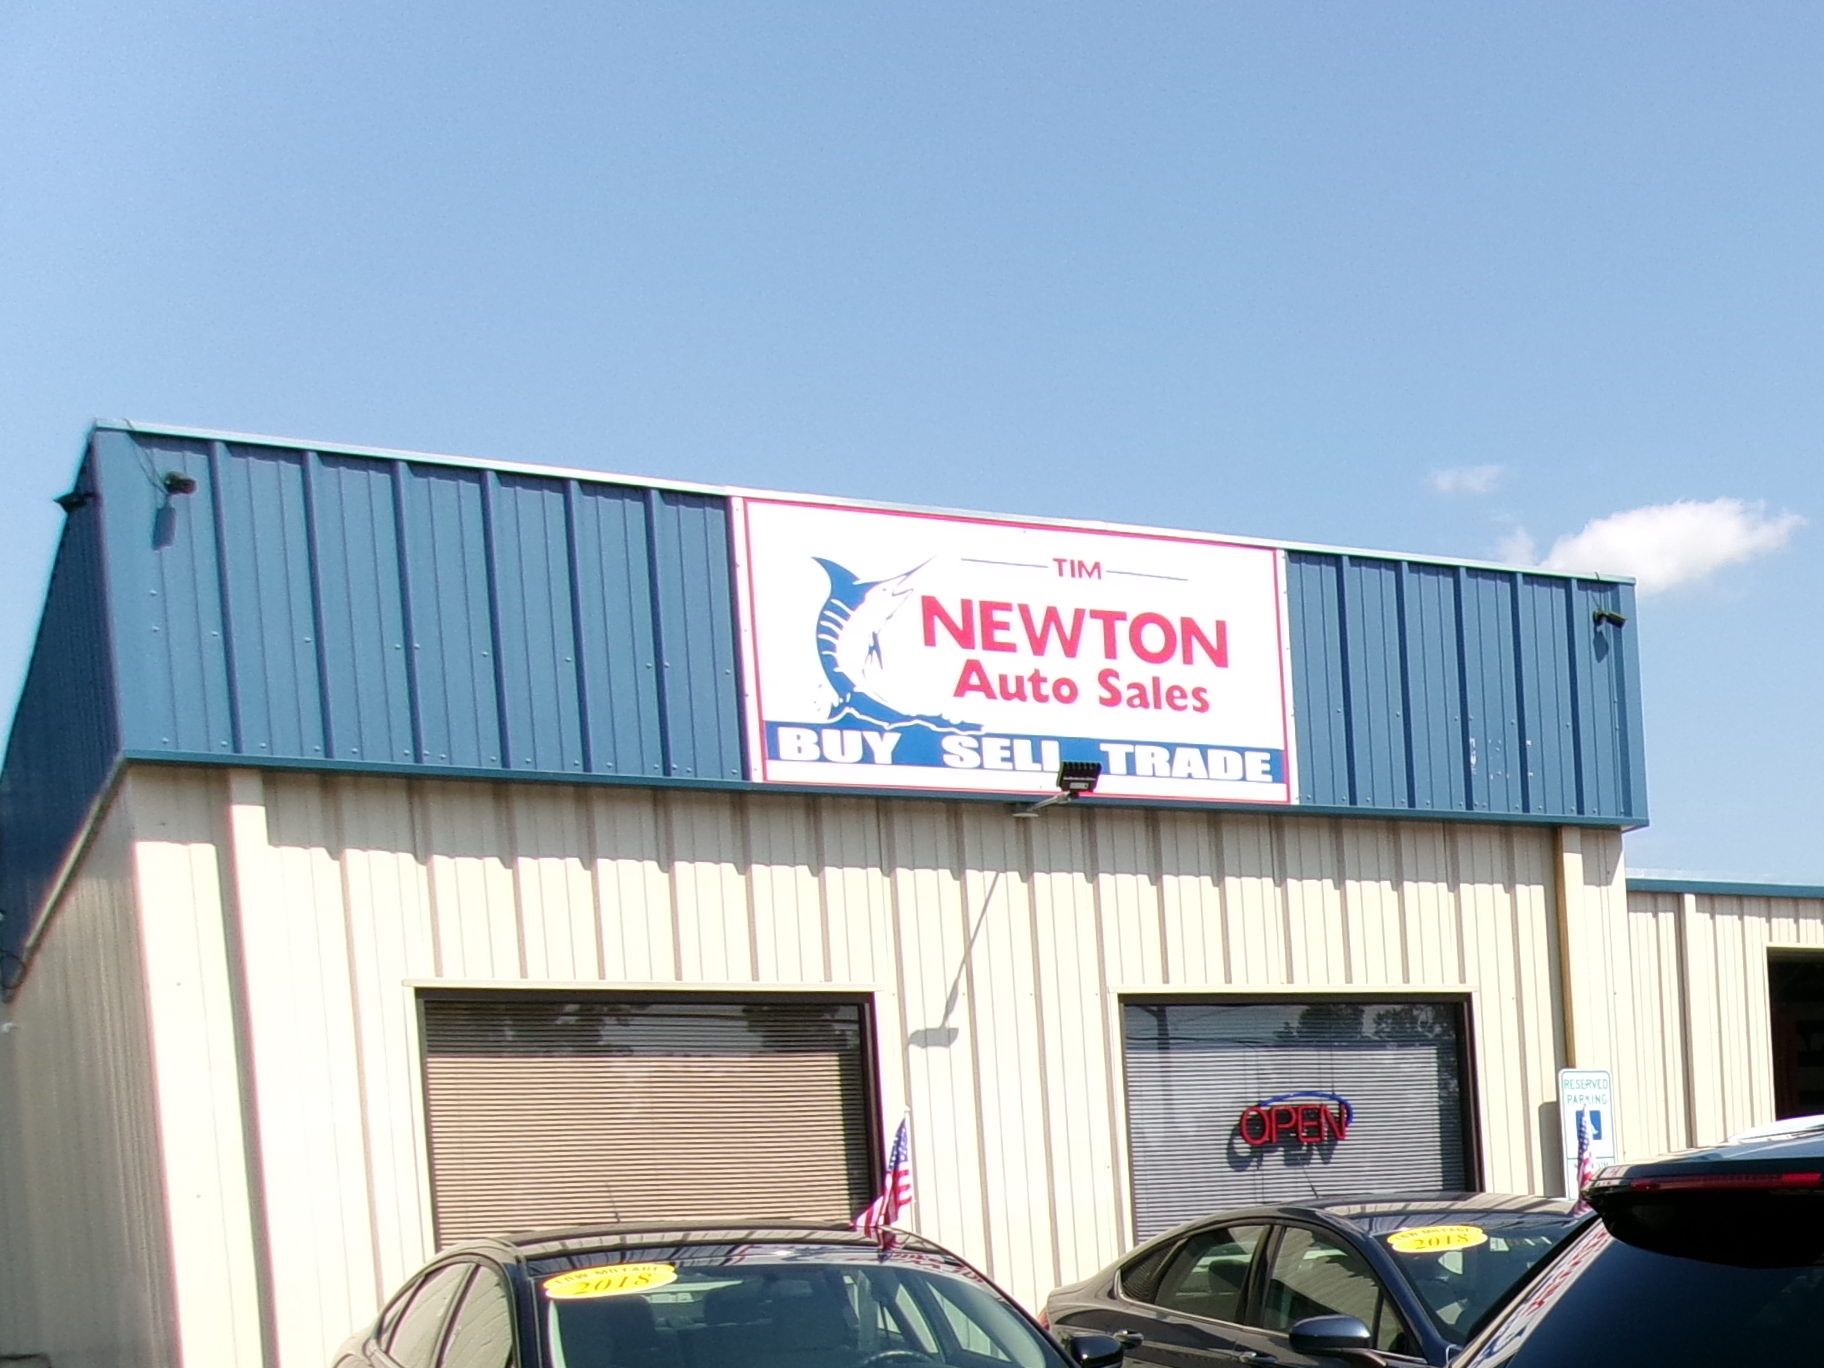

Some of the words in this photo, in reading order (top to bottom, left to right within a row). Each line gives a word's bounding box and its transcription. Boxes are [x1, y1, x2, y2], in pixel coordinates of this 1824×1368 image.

[1052, 557, 1102, 581] TIM
[921, 595, 1229, 669] NEWTON
[953, 658, 1079, 705] Auto
[1098, 667, 1211, 714] Sales
[777, 727, 901, 765] BUY
[940, 735, 1060, 773] SELL
[1100, 743, 1273, 784] TRADE
[1564, 1078, 1608, 1090] RESERVED
[1567, 1094, 1607, 1105] PARKING
[1240, 1103, 1346, 1146] OPEN
[573, 1272, 652, 1295] 2018
